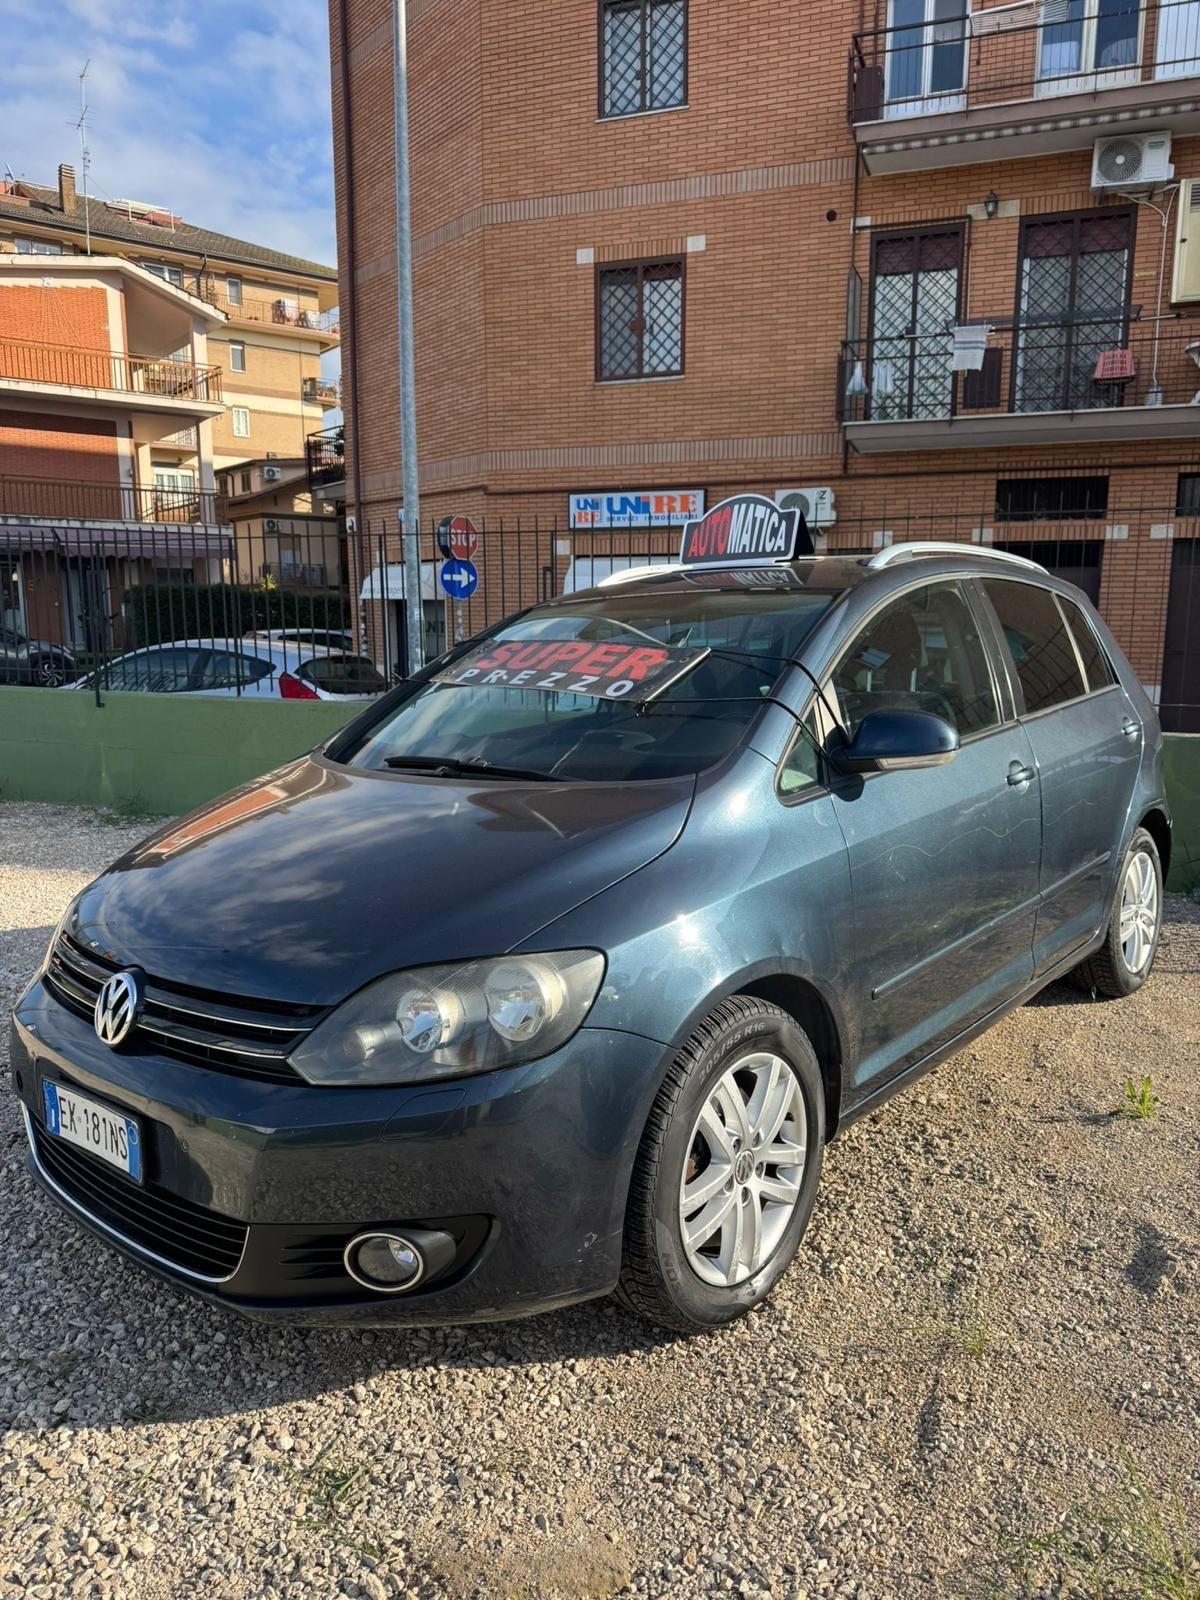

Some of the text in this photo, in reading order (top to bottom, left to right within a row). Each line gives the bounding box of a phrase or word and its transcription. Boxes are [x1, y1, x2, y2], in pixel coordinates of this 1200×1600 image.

[644, 513, 698, 521] IMOILIARI
[688, 503, 786, 557] AUTOMATICA
[450, 528, 476, 547] STOP
[476, 641, 669, 680] SUPER
[455, 668, 634, 697] PREZZO
[699, 1022, 766, 1085] 205/55 R16
